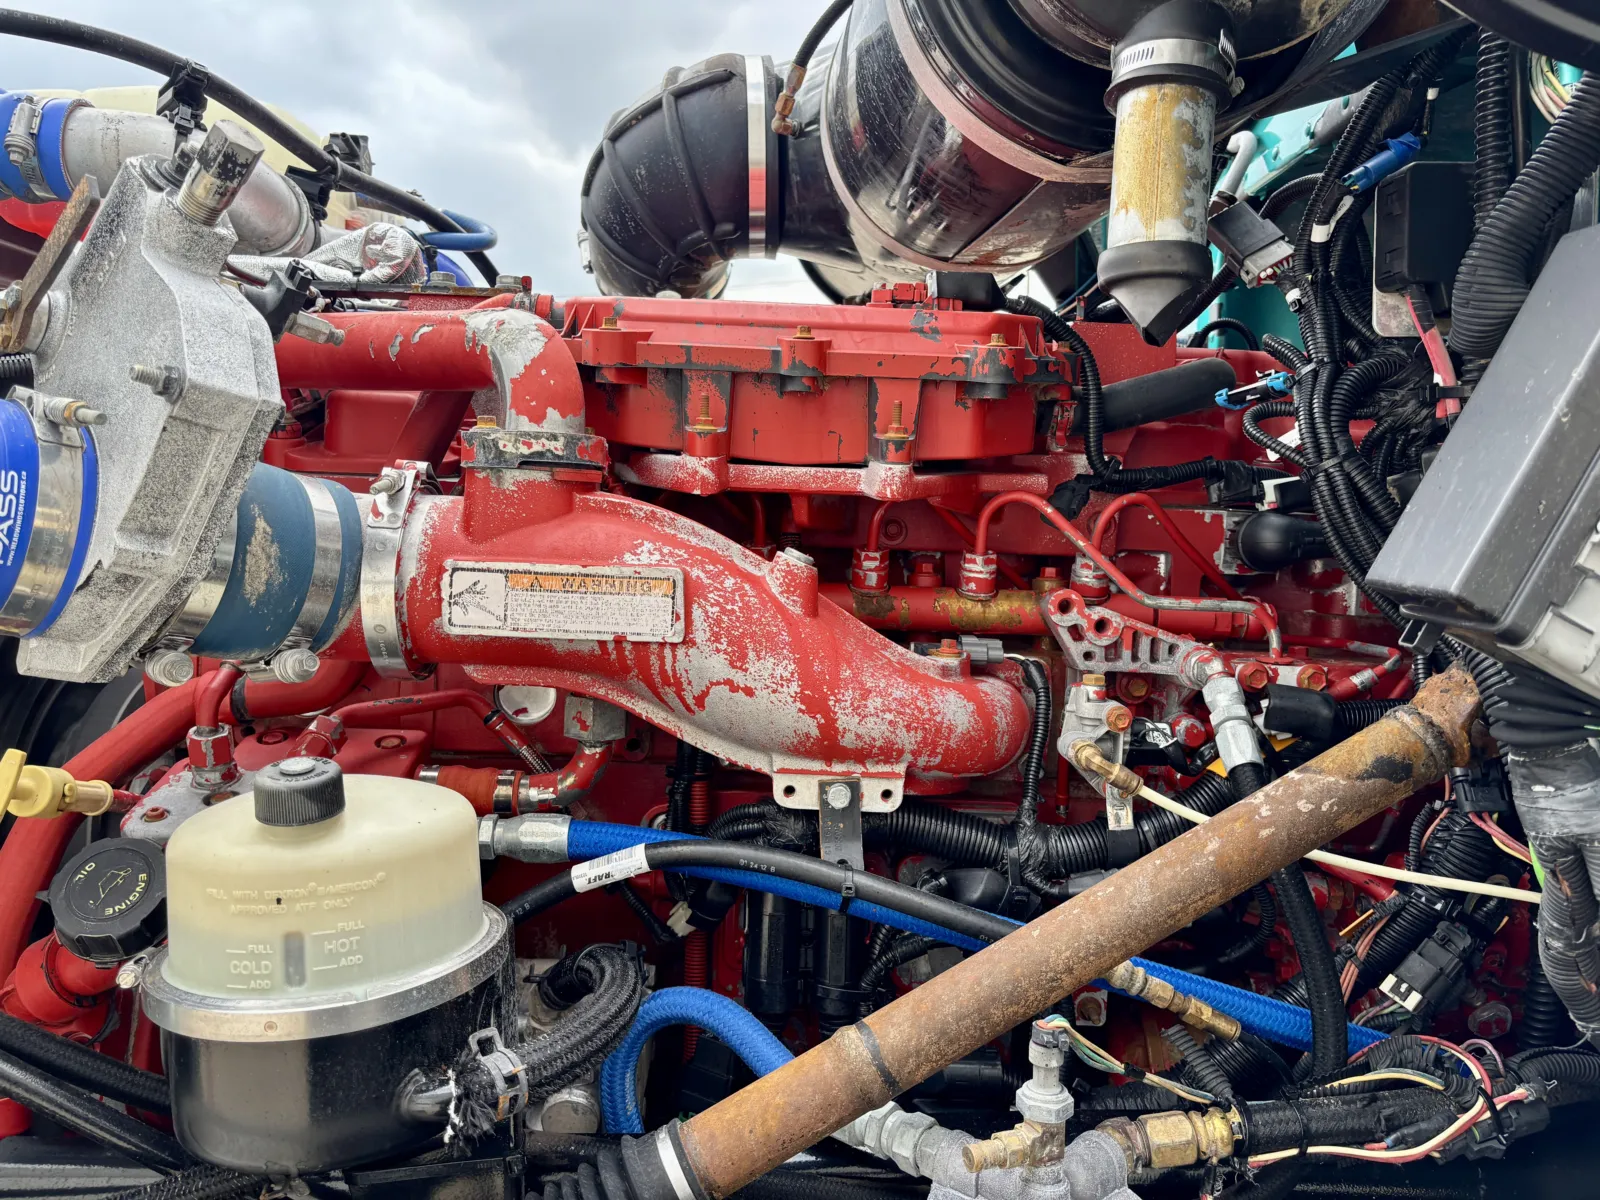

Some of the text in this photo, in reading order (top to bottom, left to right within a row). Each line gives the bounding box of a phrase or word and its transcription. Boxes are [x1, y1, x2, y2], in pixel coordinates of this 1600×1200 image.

[0, 469, 19, 565] ASS
[6, 471, 27, 567] www.HEADWINDSOLUTIONS.ca
[560, 577, 652, 593] WARNING
[74, 861, 97, 882] OIL
[749, 861, 759, 869] 24
[104, 873, 147, 916] ENGINE
[206, 887, 228, 900] FILL
[233, 889, 259, 900] WITH
[230, 896, 355, 916] APPROVED ATF ONLY
[337, 919, 365, 932] FULL
[248, 944, 274, 954] FULL
[324, 936, 361, 954] HOT
[230, 960, 273, 975] COLD
[339, 954, 364, 967] ADD
[249, 980, 271, 989] ADD
